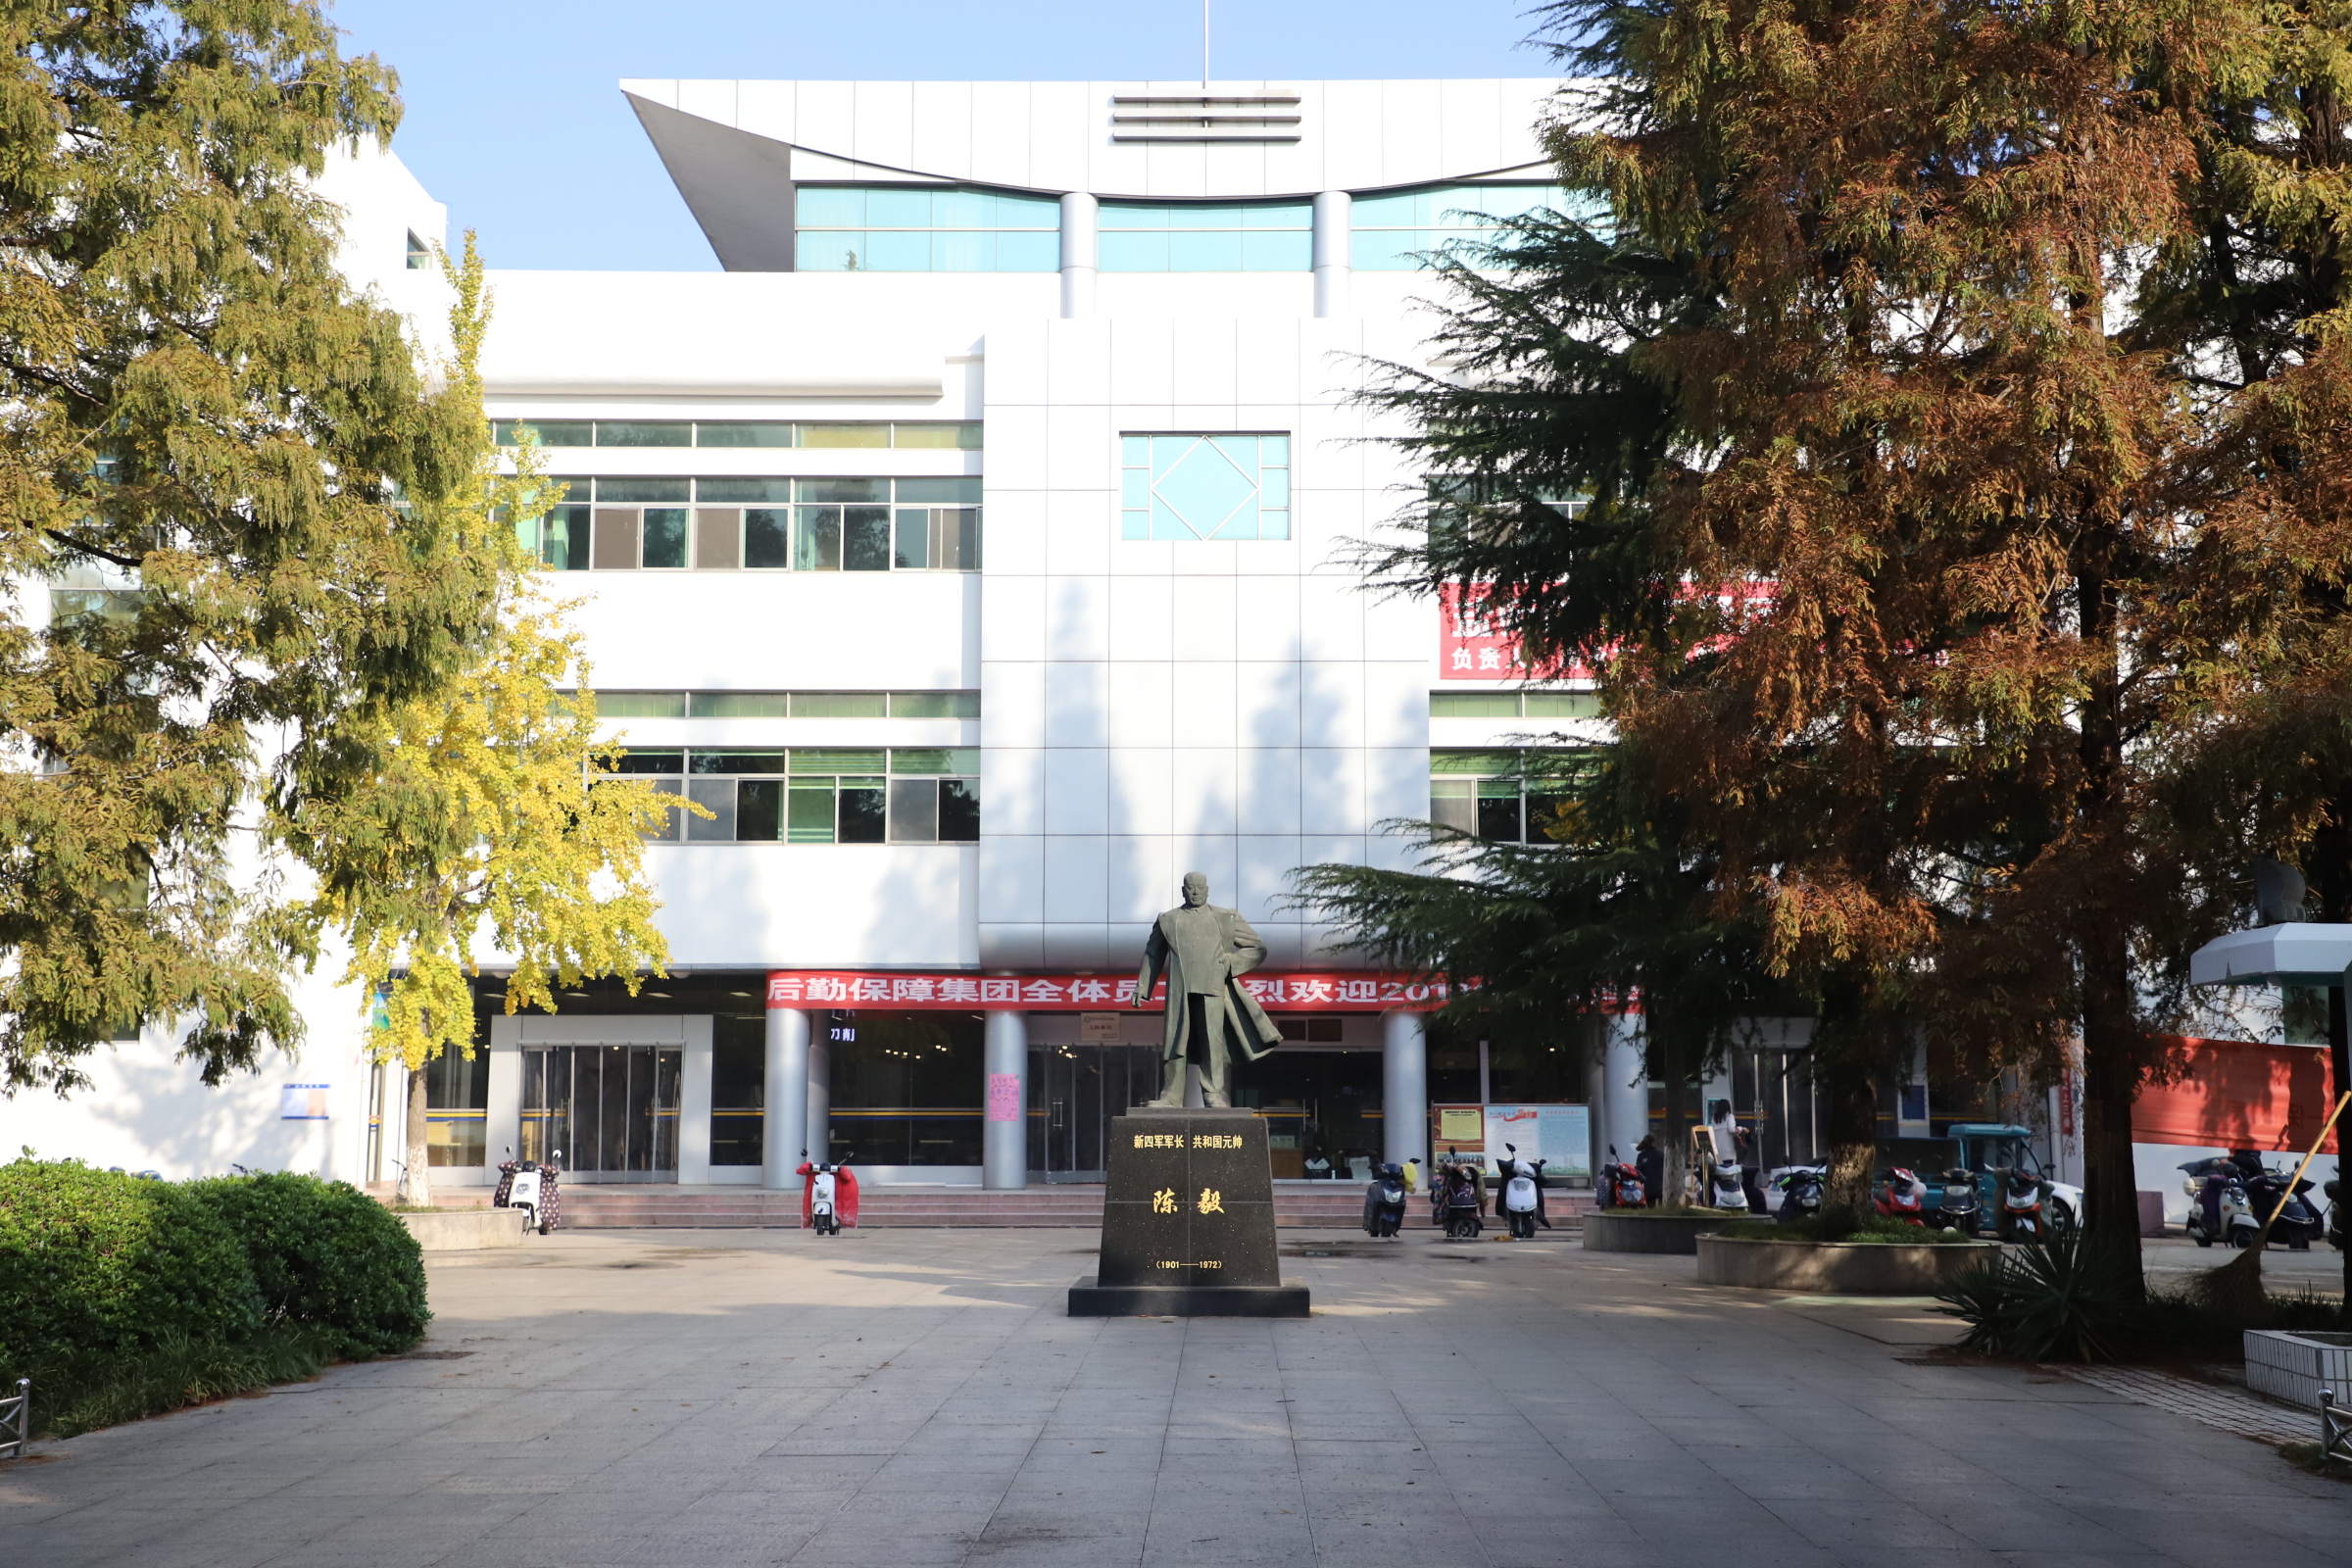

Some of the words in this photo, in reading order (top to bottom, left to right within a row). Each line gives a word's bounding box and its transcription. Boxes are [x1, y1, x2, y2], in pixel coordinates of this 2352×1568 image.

[830, 1027, 856, 1042] 刀削
[1133, 1134, 1185, 1150] 新四军军长
[1193, 1134, 1243, 1150] 共和国元帅
